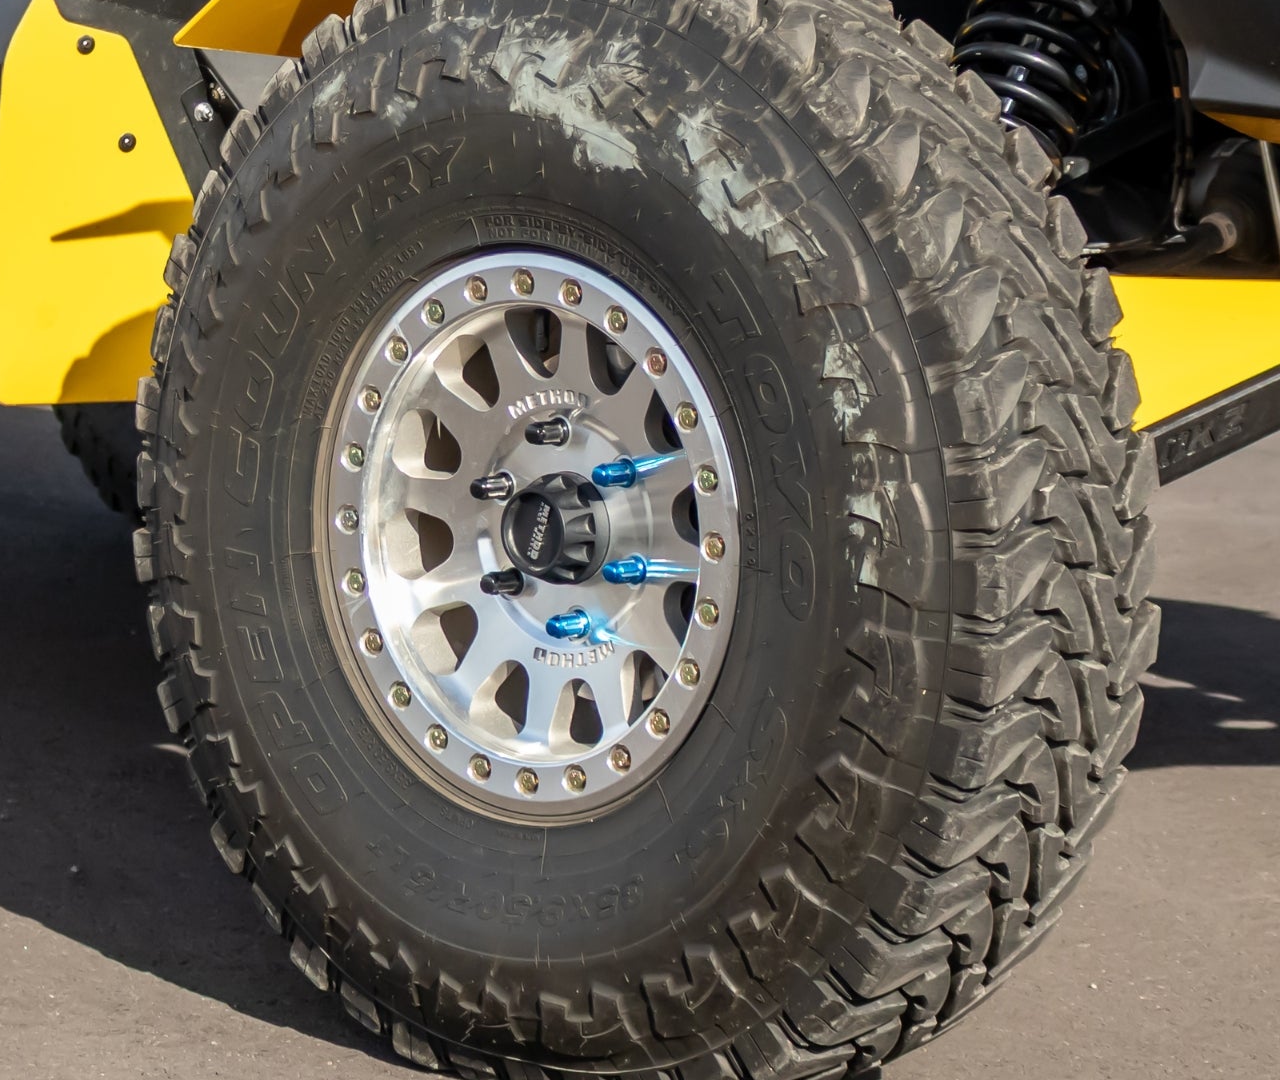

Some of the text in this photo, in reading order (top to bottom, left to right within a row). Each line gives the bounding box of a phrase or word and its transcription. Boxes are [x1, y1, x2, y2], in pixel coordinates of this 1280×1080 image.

[222, 132, 473, 507] COUNTRY
[506, 388, 591, 420] METHOD
[698, 261, 815, 626] TOYO
